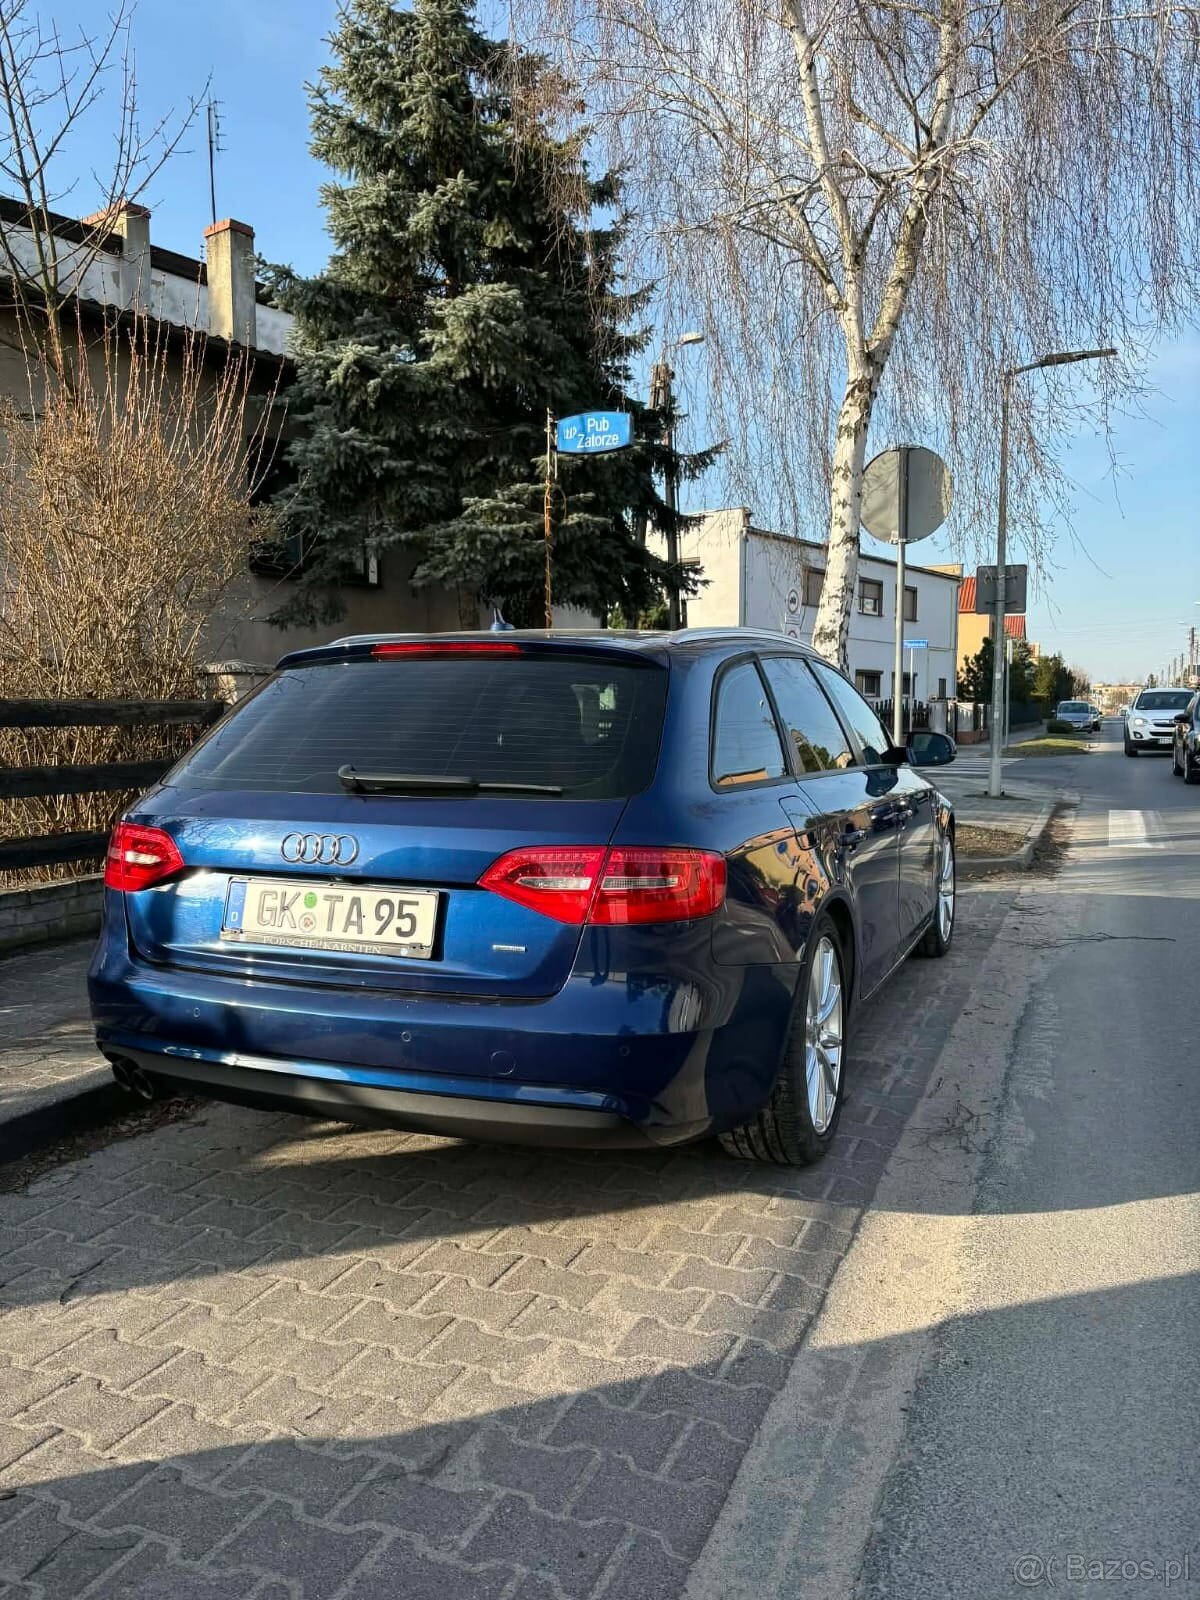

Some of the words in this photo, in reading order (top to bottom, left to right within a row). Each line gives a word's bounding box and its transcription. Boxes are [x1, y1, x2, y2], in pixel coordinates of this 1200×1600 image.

[587, 416, 610, 432] Pub
[577, 433, 620, 449] Zatorze
[230, 911, 238, 922] D
[256, 889, 301, 929] GK
[323, 893, 364, 934] TA
[374, 897, 420, 938] 95
